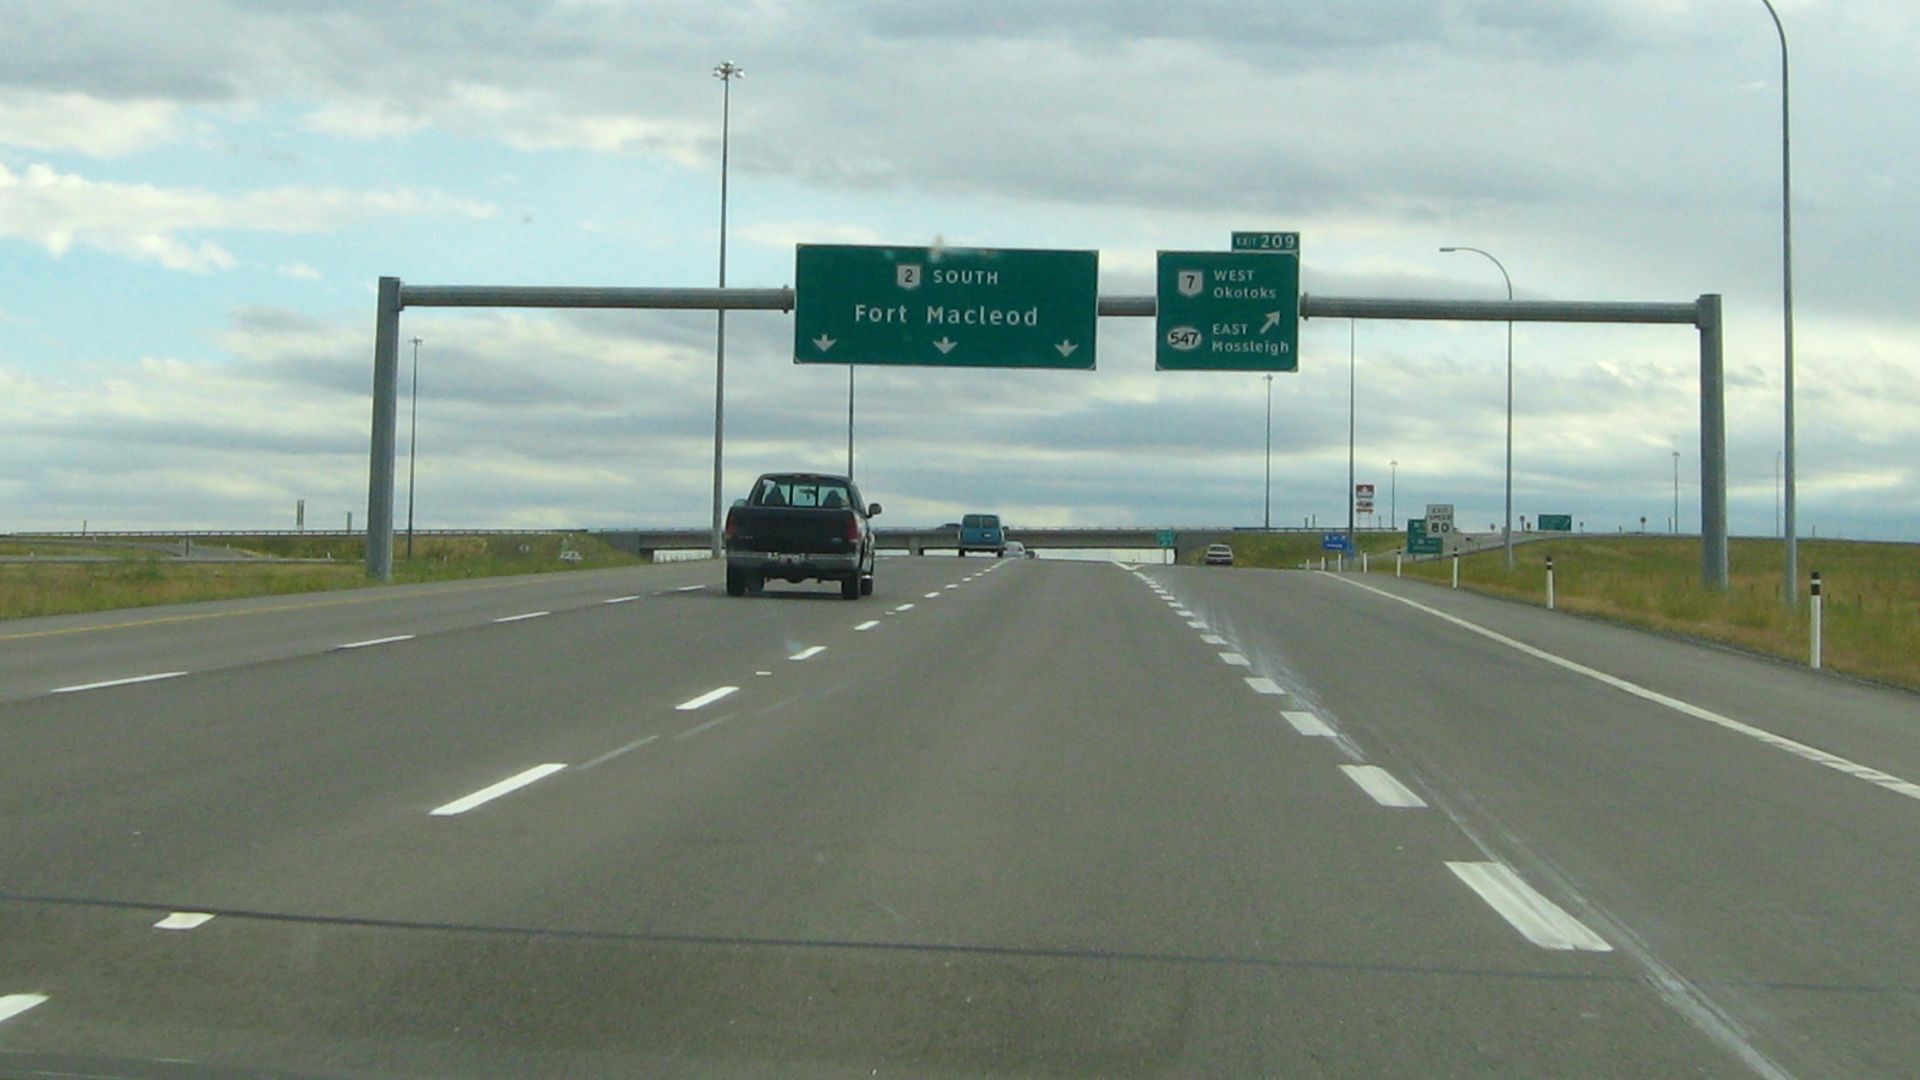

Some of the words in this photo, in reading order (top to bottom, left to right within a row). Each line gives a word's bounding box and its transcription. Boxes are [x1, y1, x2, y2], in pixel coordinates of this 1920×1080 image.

[1236, 238, 1256, 246] EXIT
[1261, 234, 1295, 248] 209
[904, 269, 914, 283] 2
[933, 270, 998, 284] SOUTH
[1186, 275, 1195, 289] 7
[1213, 270, 1254, 281] WEST
[1213, 287, 1276, 299] Okotoks
[855, 304, 907, 323] Fort
[927, 305, 1038, 326] Macleod
[1212, 323, 1248, 335] EAST
[1170, 332, 1197, 346] 547
[1212, 340, 1289, 355] Mossleigh
[1431, 522, 1449, 533] 80
